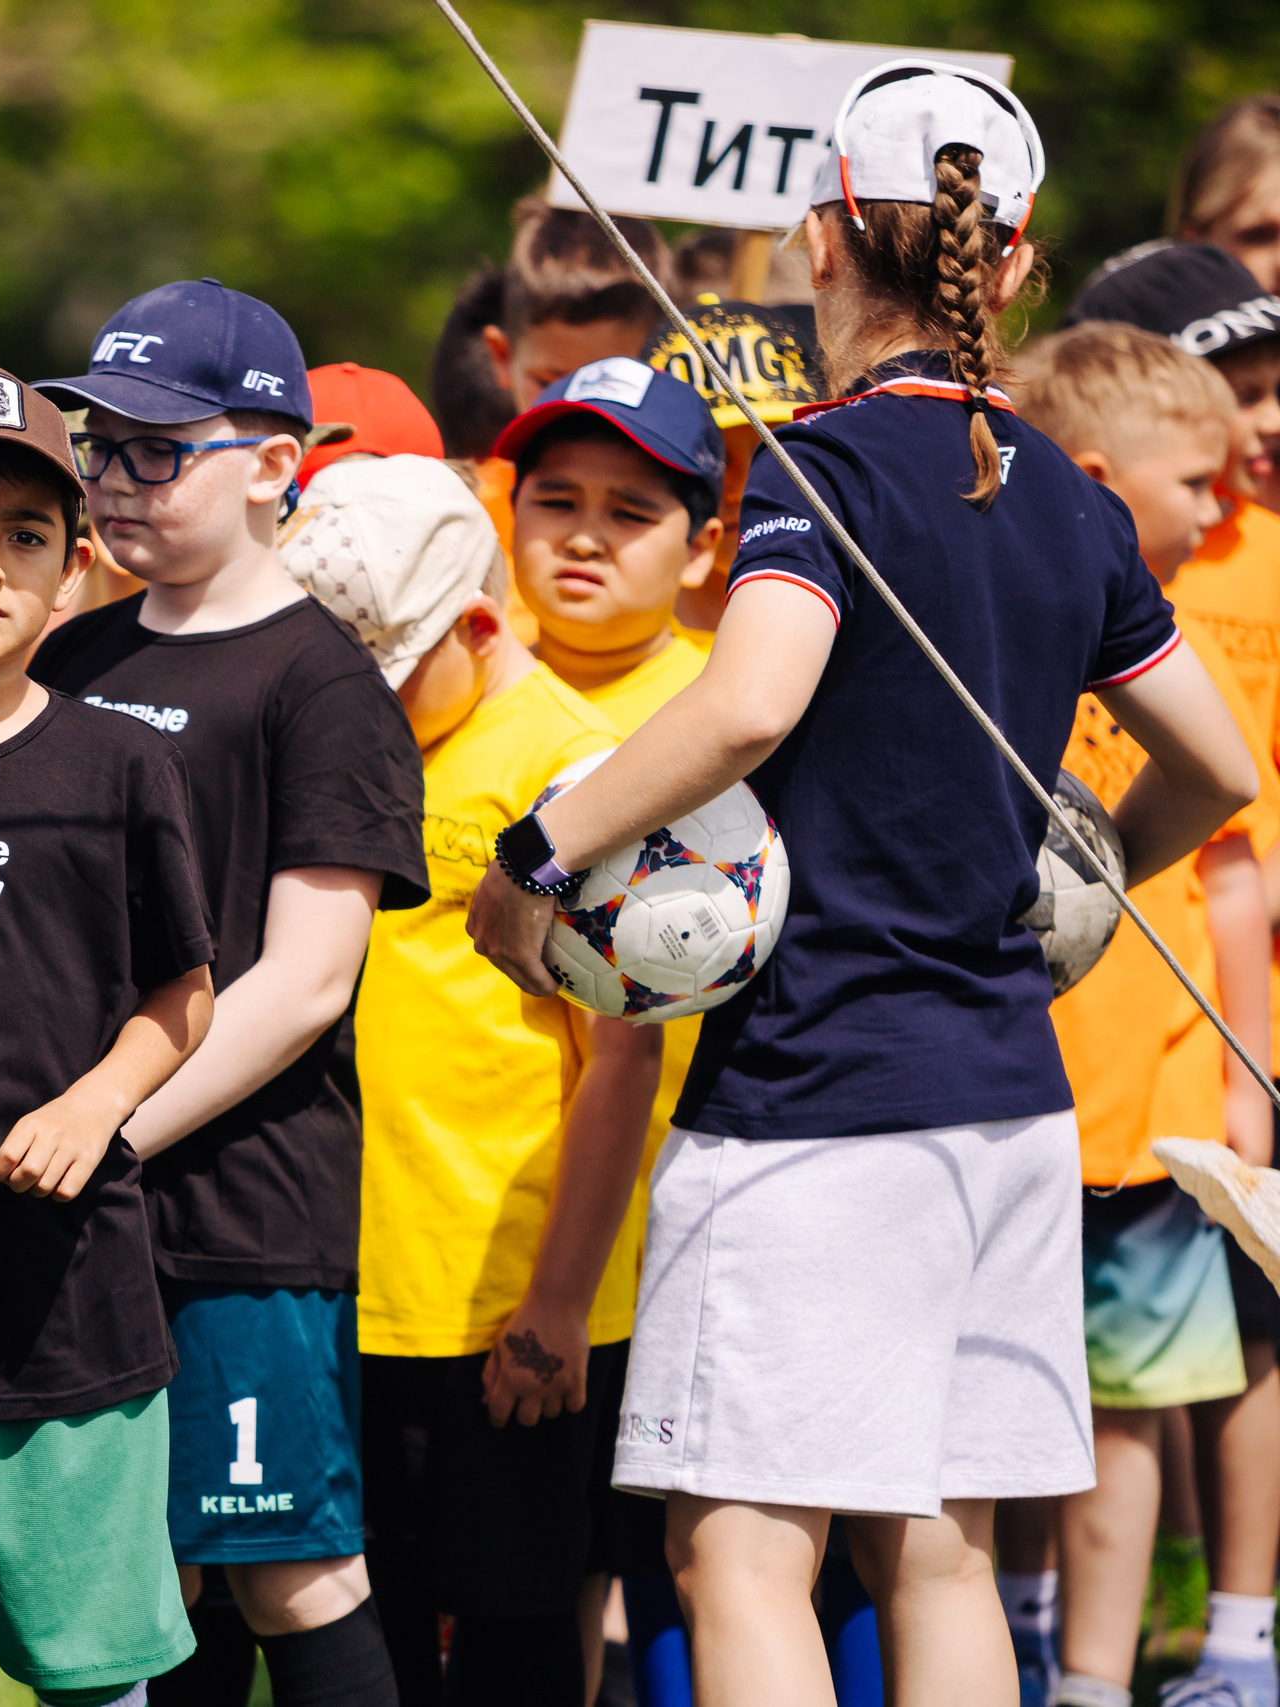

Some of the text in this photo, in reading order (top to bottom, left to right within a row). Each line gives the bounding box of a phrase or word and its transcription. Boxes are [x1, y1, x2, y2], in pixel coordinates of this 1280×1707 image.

[639, 87, 831, 195] Тит
[93, 331, 164, 364] UFC
[665, 334, 786, 393] OMG
[242, 369, 285, 397] UFC
[228, 1397, 263, 1484] 1
[201, 1493, 293, 1514] KELME
